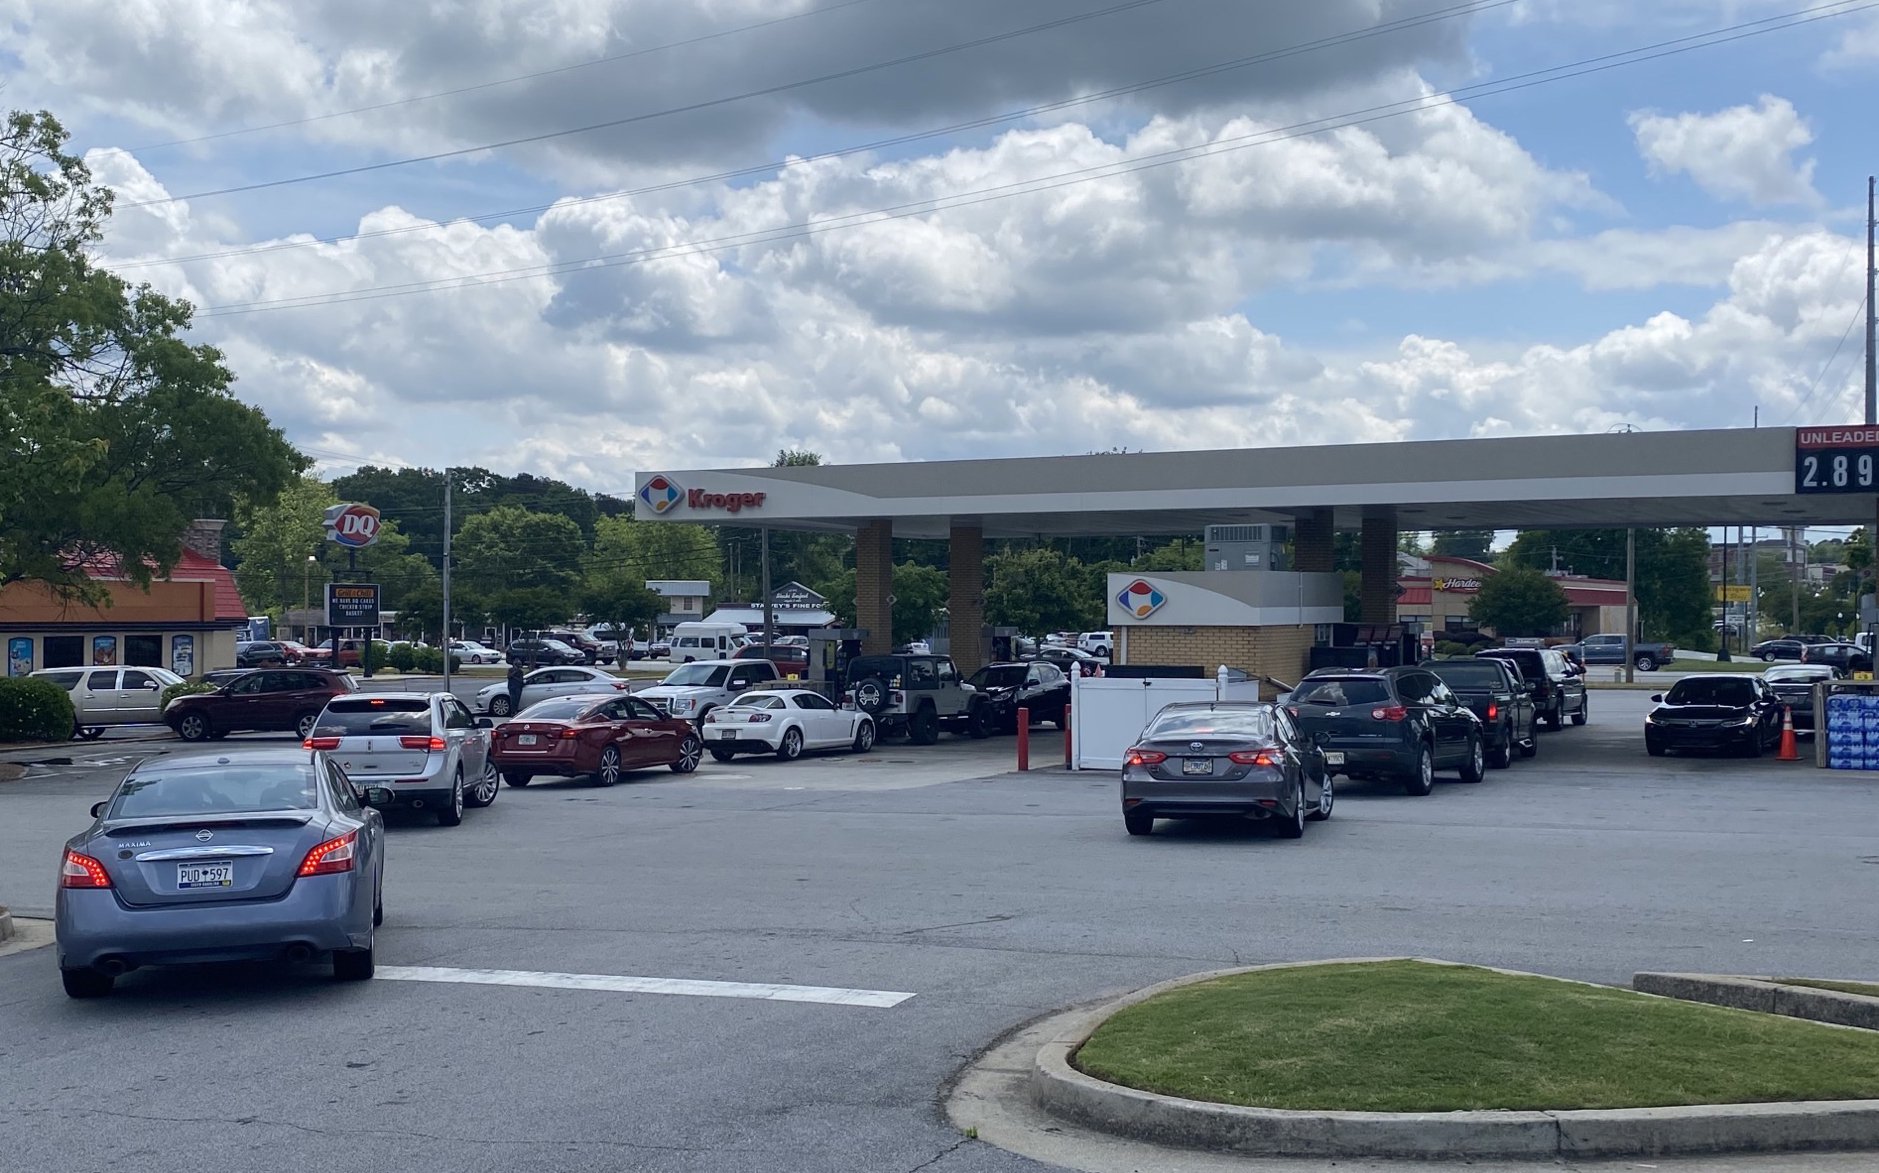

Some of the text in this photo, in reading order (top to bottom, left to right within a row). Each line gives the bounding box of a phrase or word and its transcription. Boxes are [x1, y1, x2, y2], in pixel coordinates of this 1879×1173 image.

[1801, 431, 1879, 444] UNLEADE
[1803, 454, 1873, 487] 2.89
[688, 488, 766, 512] Kroger
[342, 514, 375, 538] DQ
[117, 840, 152, 848] MAXIMA
[180, 867, 229, 882] PUD 597
